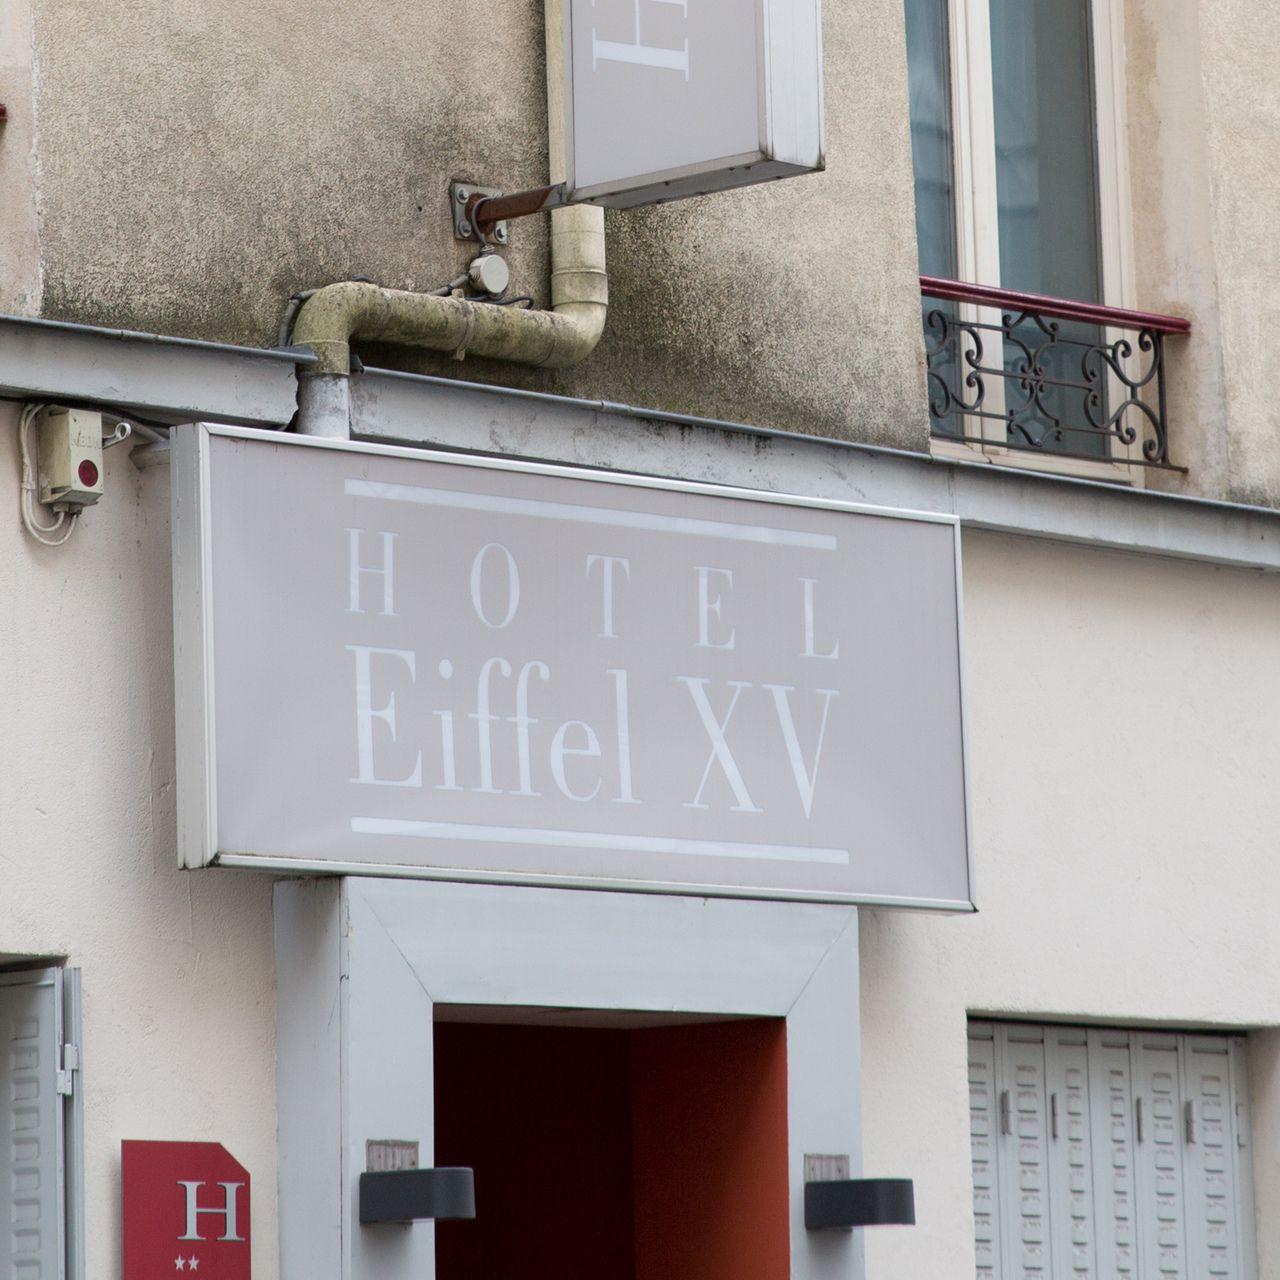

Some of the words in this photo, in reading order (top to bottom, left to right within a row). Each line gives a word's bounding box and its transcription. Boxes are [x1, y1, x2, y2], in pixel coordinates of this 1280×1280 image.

[344, 527, 841, 660] HOTEL
[344, 644, 644, 805] Eiffel
[675, 675, 842, 820] XV
[176, 1180, 246, 1241] H
